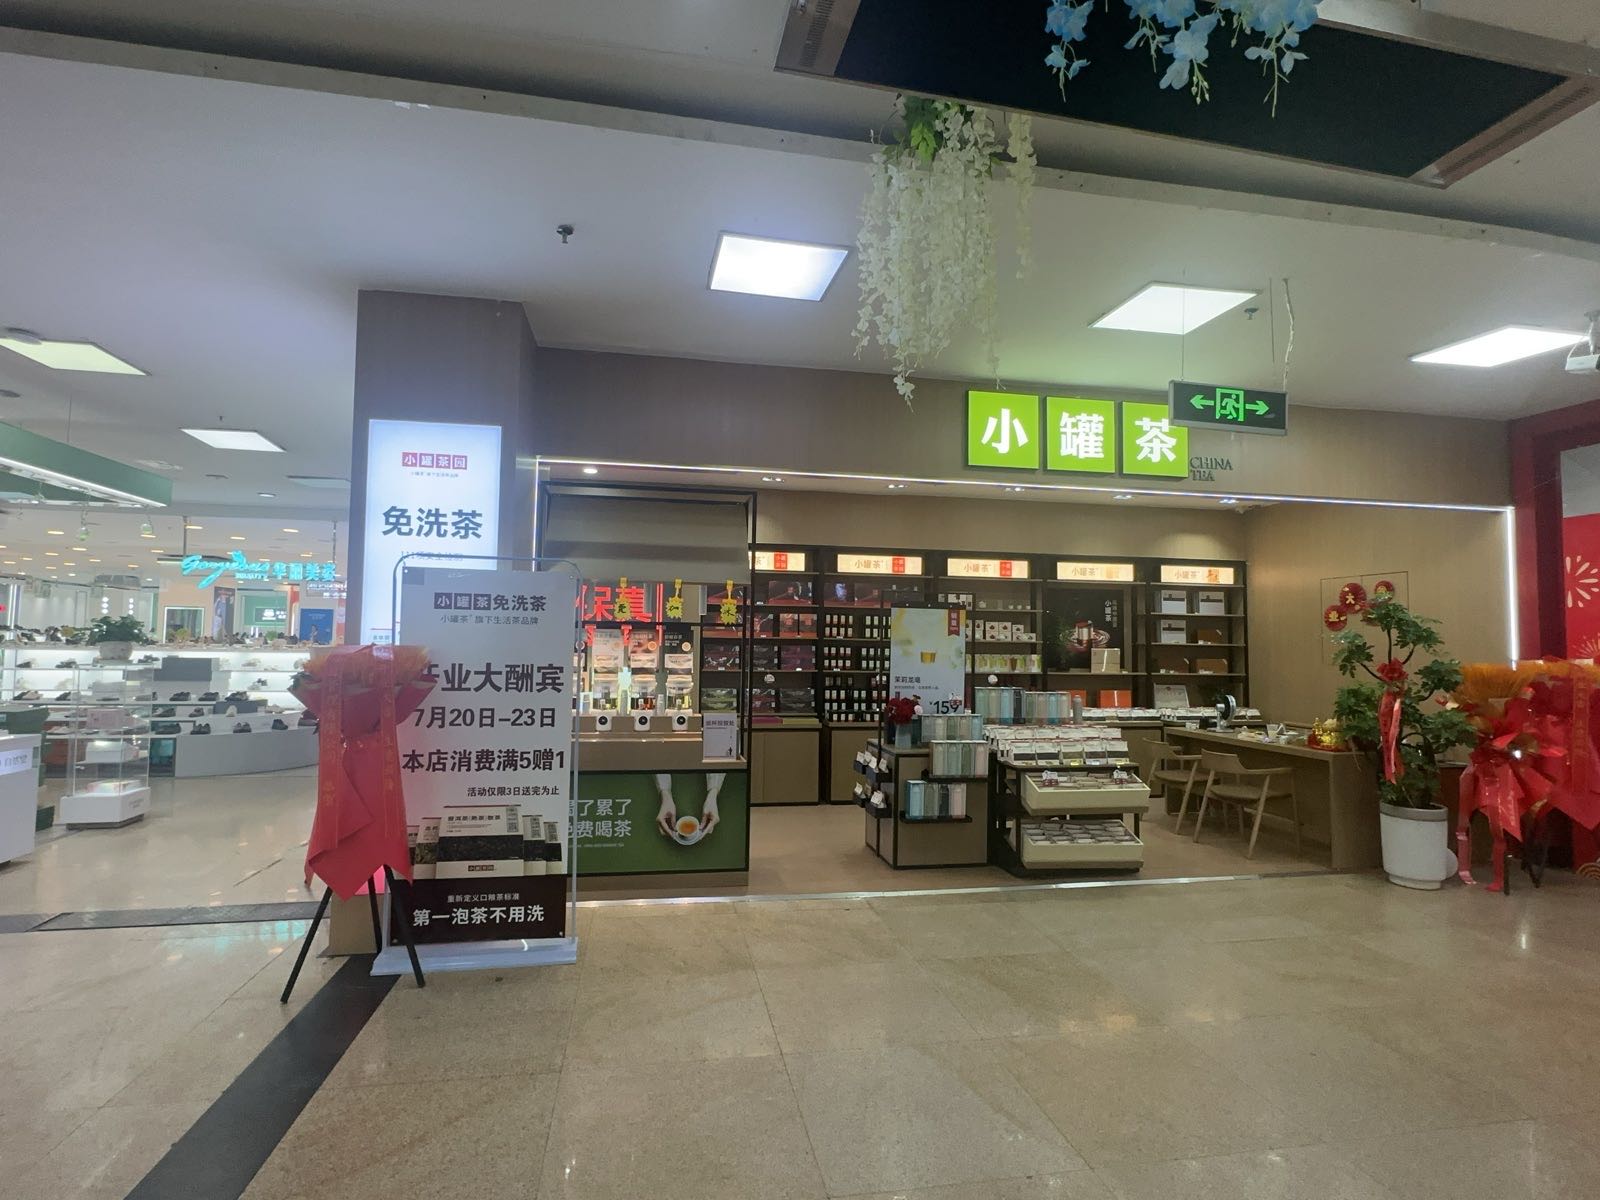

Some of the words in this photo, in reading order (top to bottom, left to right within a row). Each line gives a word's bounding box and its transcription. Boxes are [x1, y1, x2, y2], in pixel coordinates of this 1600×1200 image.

[981, 407, 1177, 463] 小罐茶
[402, 452, 467, 470] 小罐茶园
[1189, 456, 1233, 471] CHINA
[1190, 470, 1214, 482] TEA
[382, 505, 483, 540] 免洗茶
[434, 592, 547, 612] 小罐茶免洗茶
[402, 748, 565, 773] 本店消费满5赠1
[467, 785, 560, 797] 活动仅限3日送完为止
[447, 893, 520, 903] 重新定义口粮茶标准
[413, 905, 545, 927] 第一泡茶不用洗
